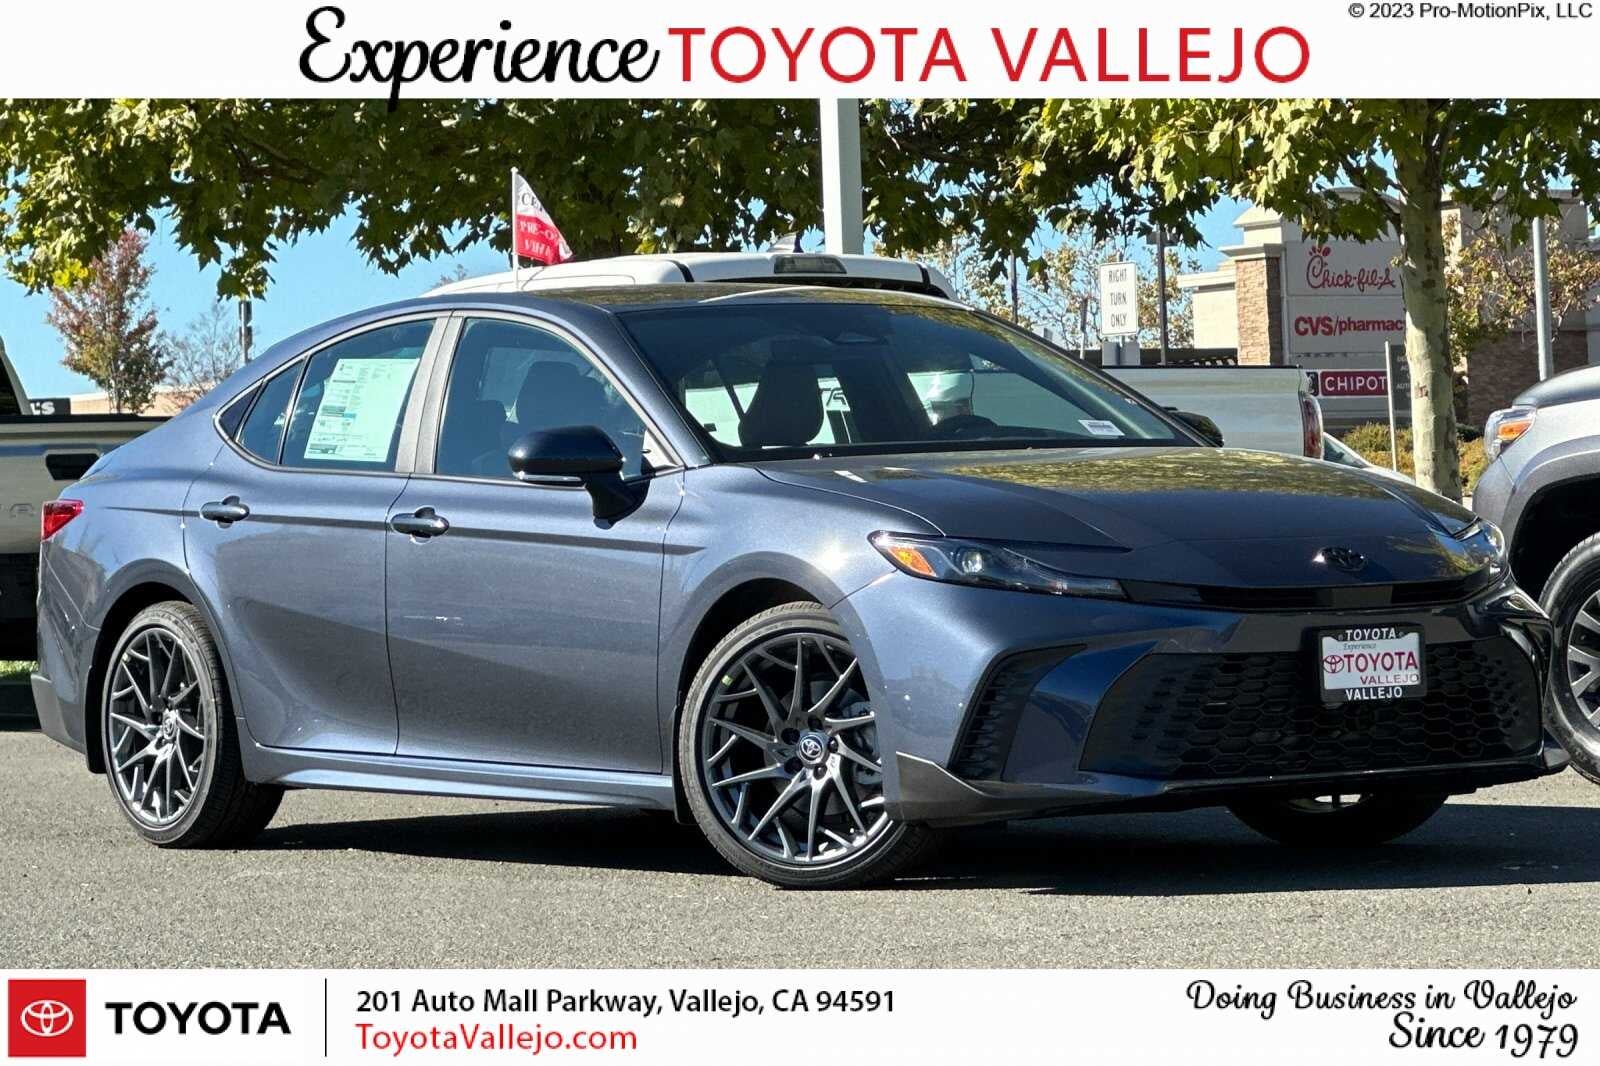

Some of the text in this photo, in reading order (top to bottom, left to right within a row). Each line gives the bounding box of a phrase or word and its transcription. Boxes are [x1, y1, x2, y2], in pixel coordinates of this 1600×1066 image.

[1108, 268, 1127, 283] RIGHT
[1307, 248, 1396, 292] Chick-fil-A
[1110, 291, 1127, 306] TURN
[1110, 313, 1127, 328] ONLY
[1295, 315, 1405, 336] CVS/pharmac
[1325, 376, 1387, 391] CHIPOT
[1345, 627, 1397, 641] TOYOTA
[1343, 642, 1377, 652] Experience
[1344, 651, 1418, 673] TOYOTA
[1360, 673, 1420, 685] VALLEJO
[1345, 686, 1403, 701] VALLEJO
